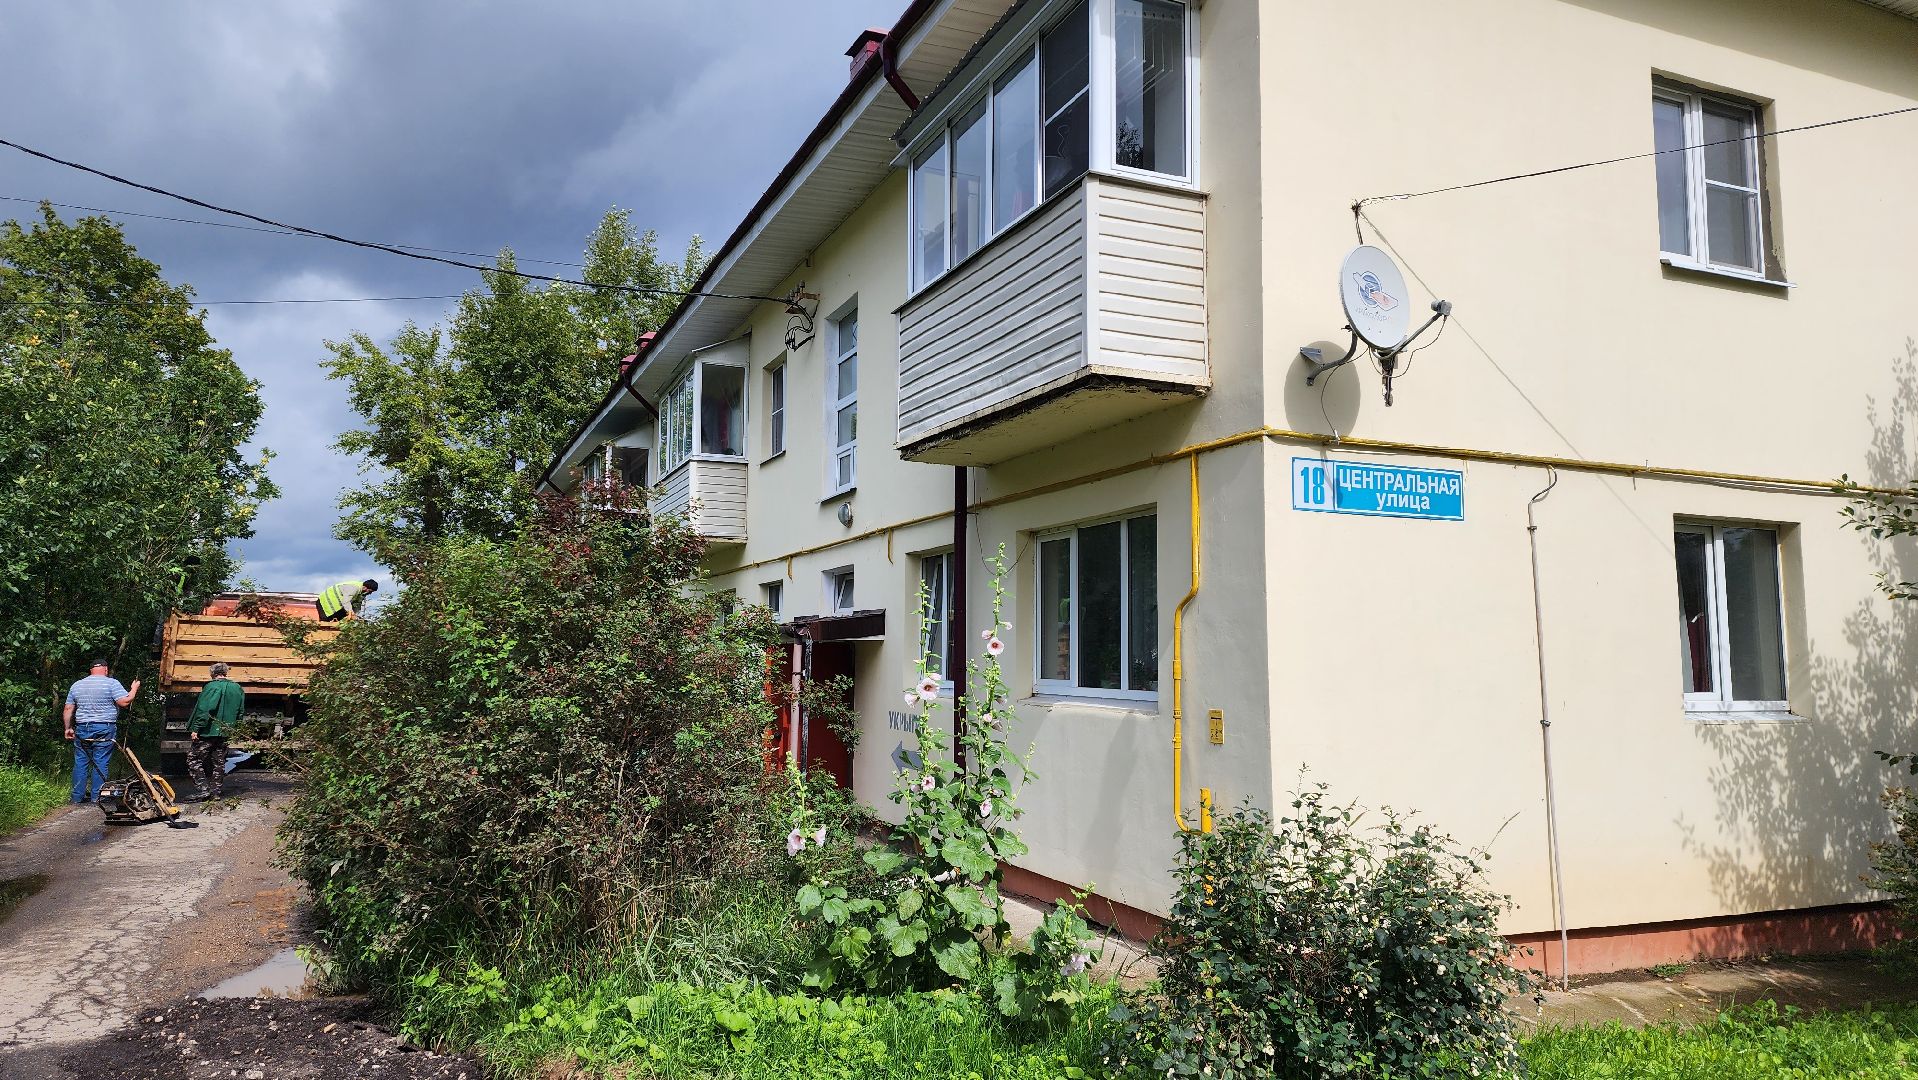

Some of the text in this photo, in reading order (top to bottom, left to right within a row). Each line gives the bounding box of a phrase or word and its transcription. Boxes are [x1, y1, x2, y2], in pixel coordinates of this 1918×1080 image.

[1300, 466, 1325, 504] 18
[1339, 468, 1460, 496] ЦЕНТРАЛЬНАЯ
[1376, 492, 1431, 512] улица
